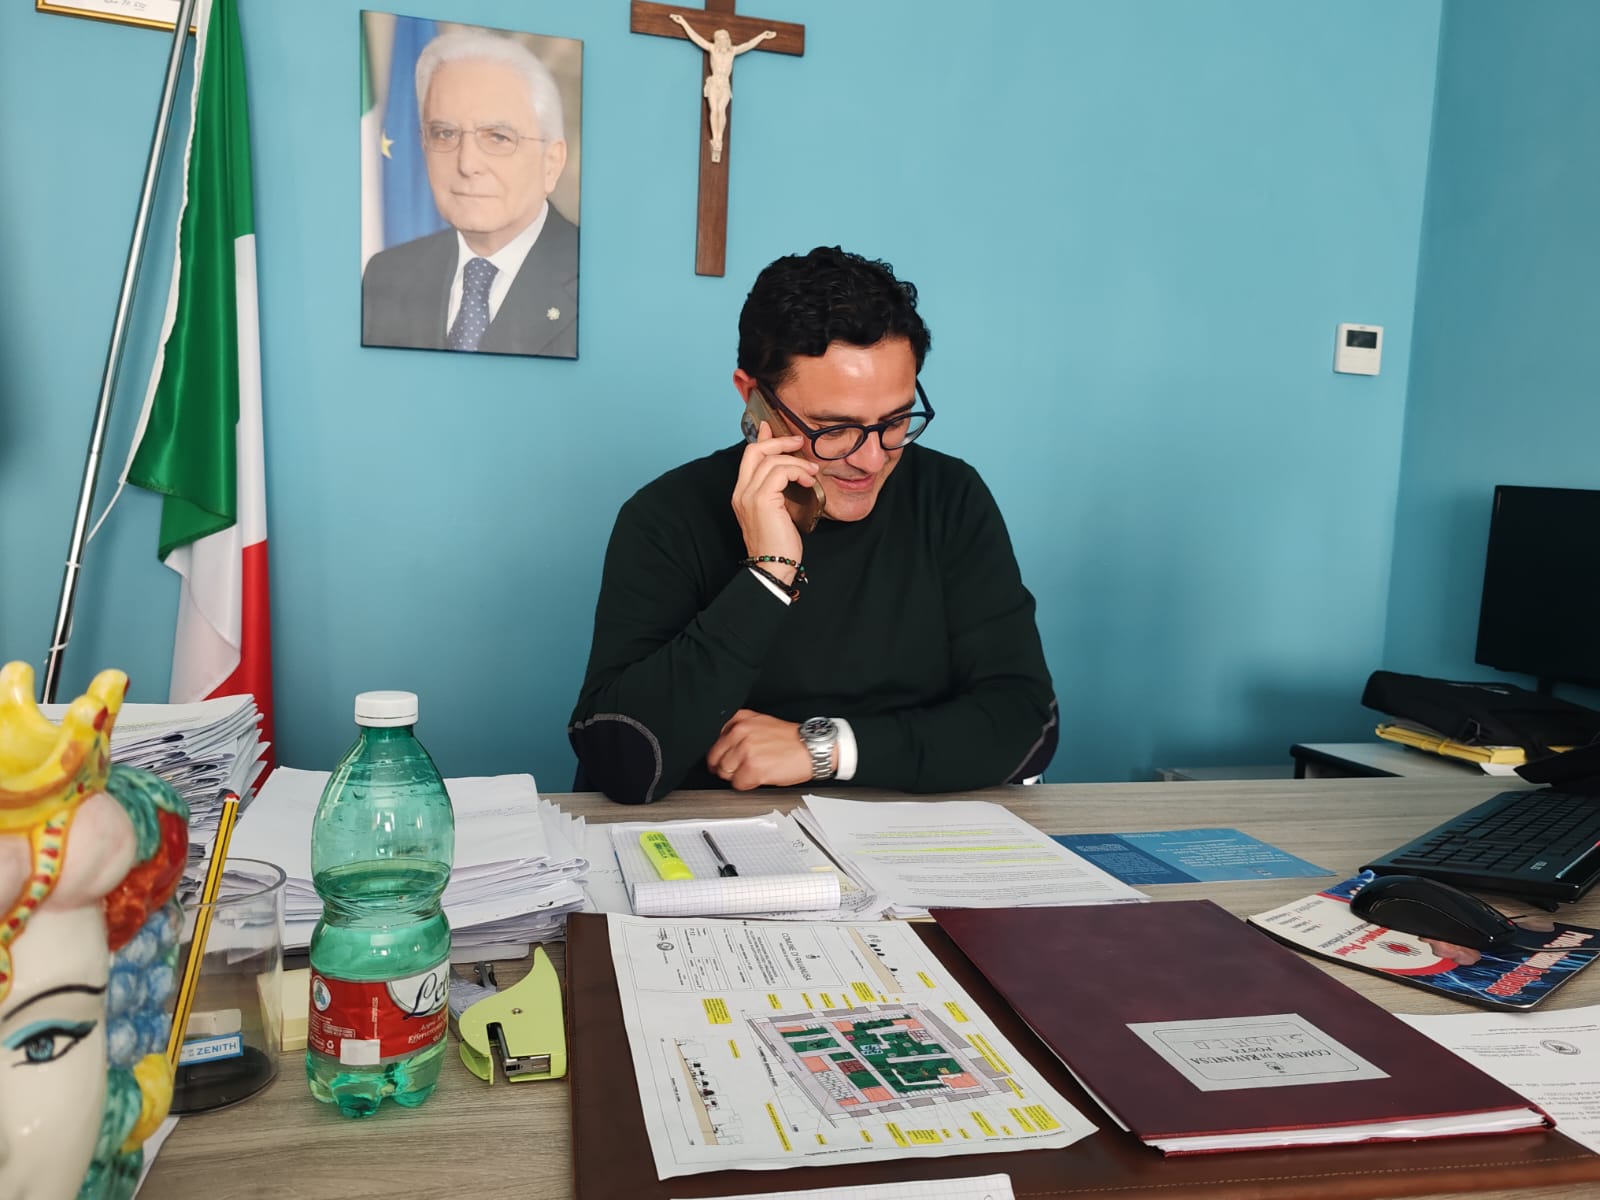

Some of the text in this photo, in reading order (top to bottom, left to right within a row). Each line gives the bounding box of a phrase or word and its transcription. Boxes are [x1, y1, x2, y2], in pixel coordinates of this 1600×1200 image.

[196, 1042, 237, 1056] ZENITH
[1230, 1045, 1273, 1055] POSTA
[1274, 1047, 1331, 1061] COMUNE
[1189, 1052, 1260, 1066] RAVANUSA
